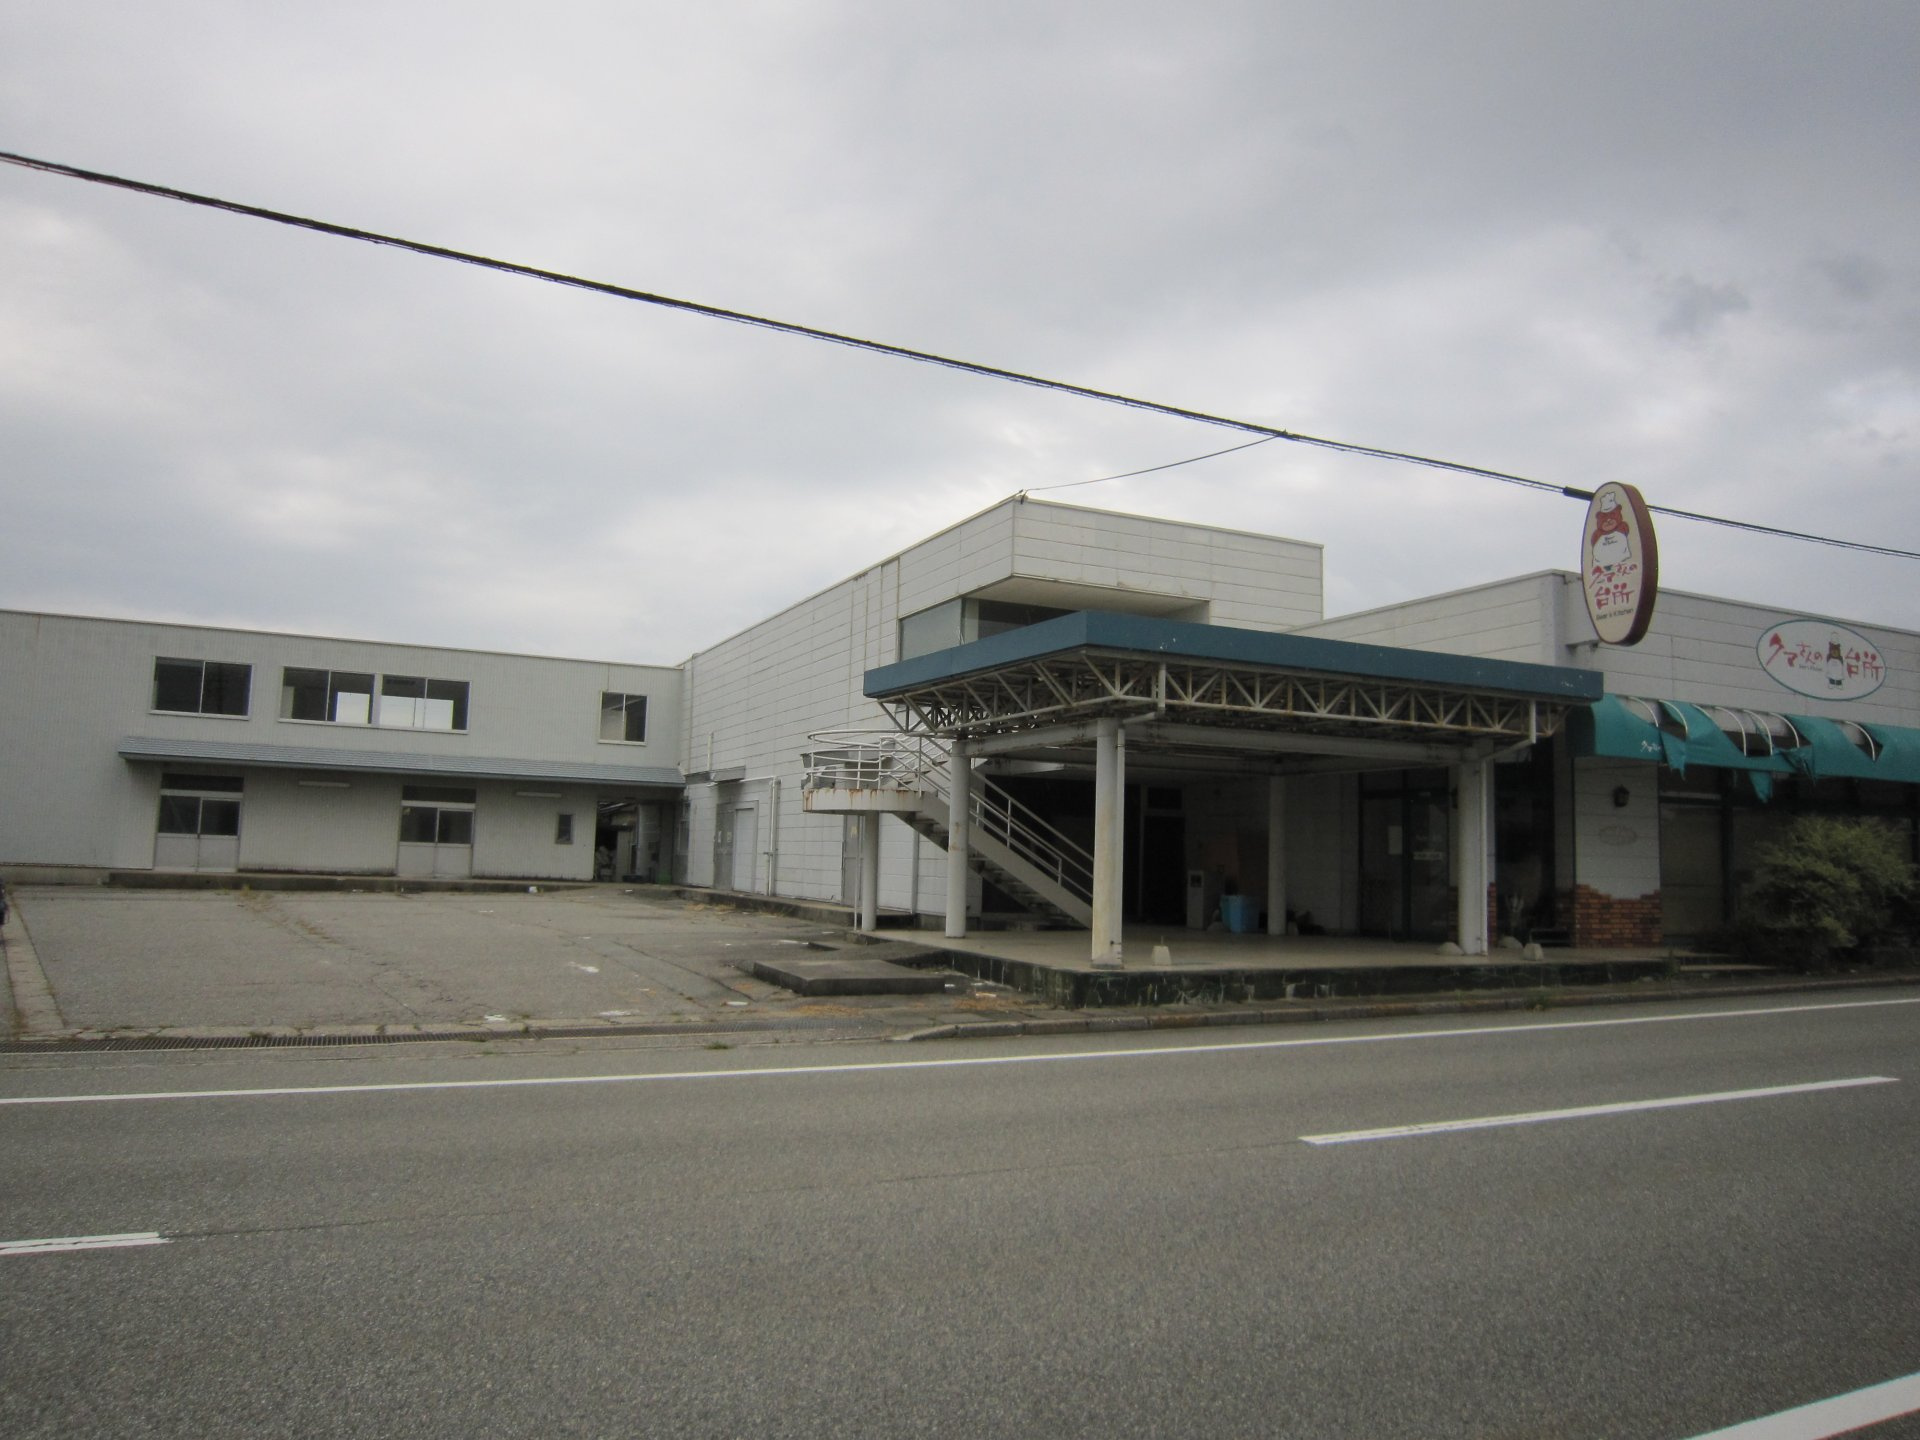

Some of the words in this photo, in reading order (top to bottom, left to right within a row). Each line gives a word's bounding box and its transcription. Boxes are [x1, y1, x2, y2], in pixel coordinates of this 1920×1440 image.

[1589, 563, 1638, 589] クマさんの
[1595, 582, 1635, 610] 台所
[1765, 632, 1823, 668] クマさんの
[1845, 647, 1883, 681] 台所
